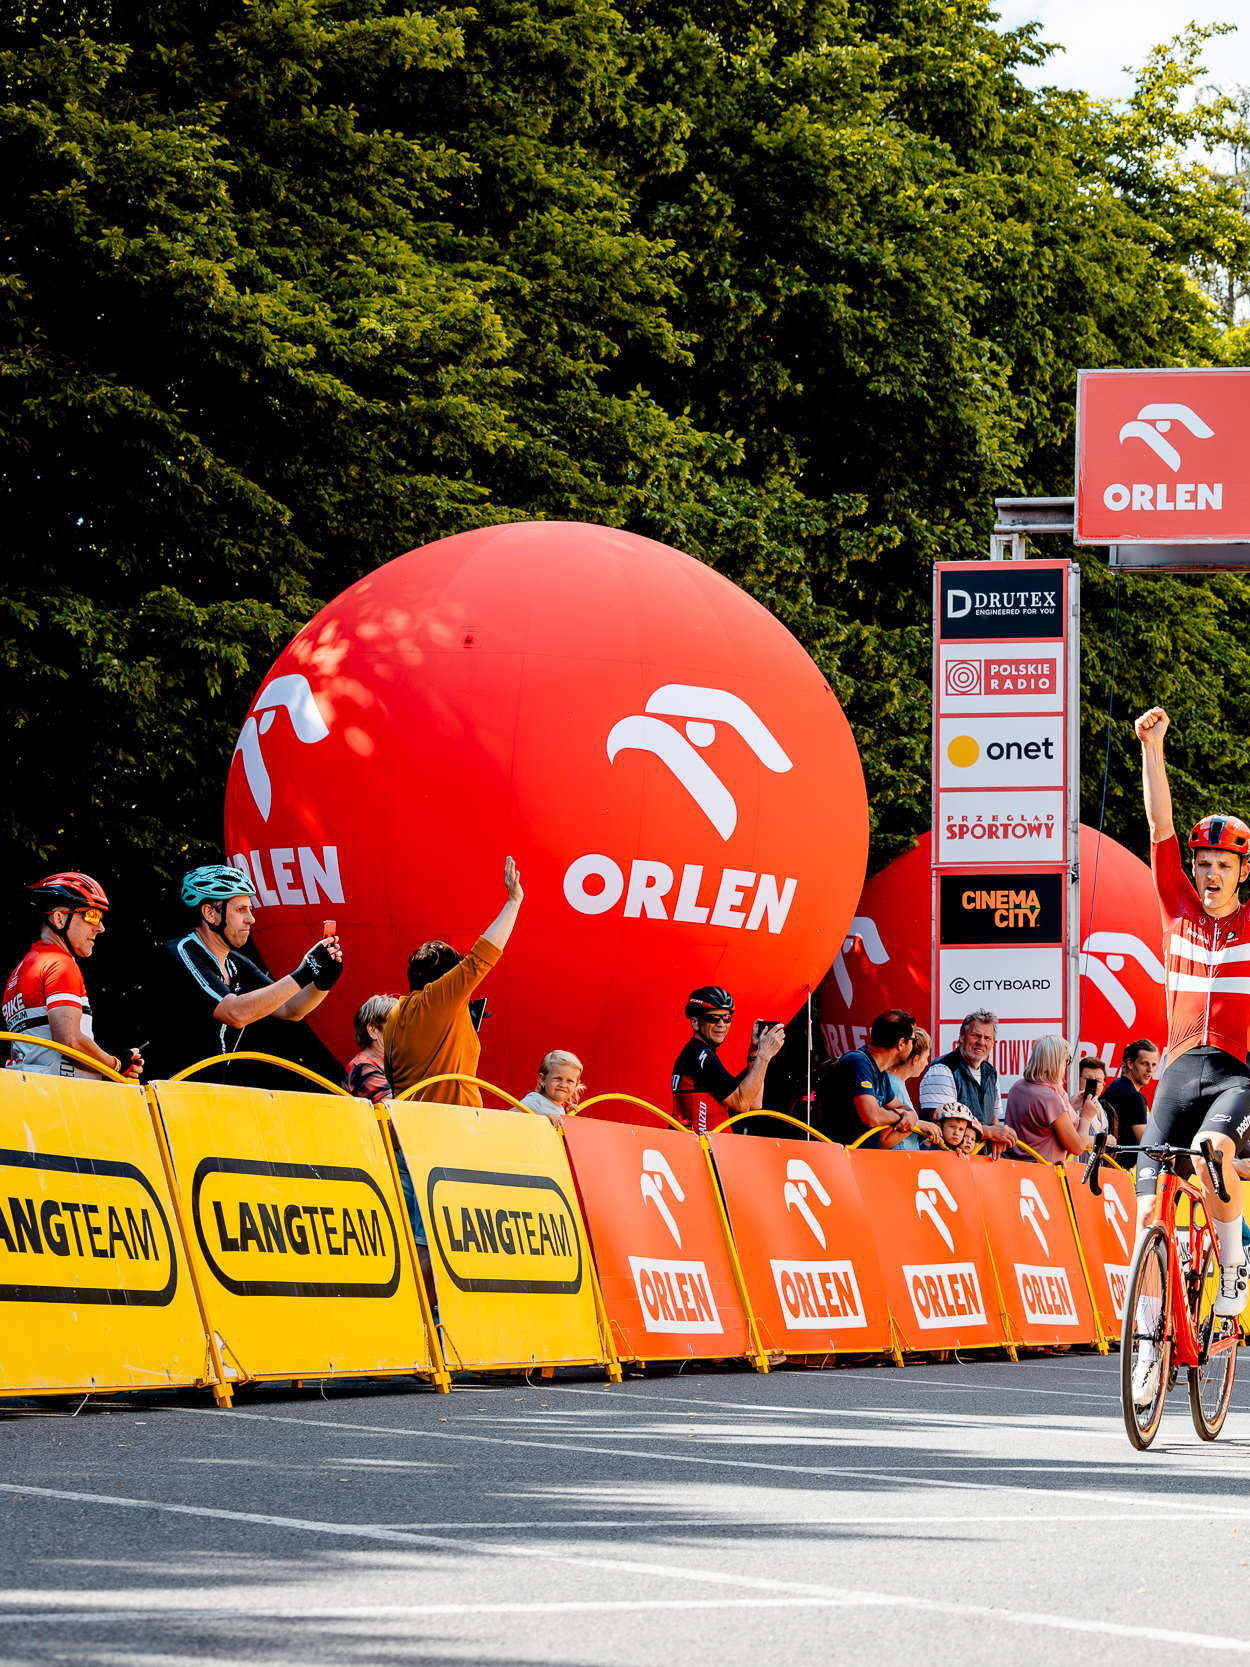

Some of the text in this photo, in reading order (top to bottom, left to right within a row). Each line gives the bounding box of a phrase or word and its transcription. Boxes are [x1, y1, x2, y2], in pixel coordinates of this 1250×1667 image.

[1103, 483, 1223, 511] ORLEN
[974, 591, 1056, 608] DRUTEX
[975, 608, 1020, 616] ENGINEERED
[1039, 607, 1055, 615] YOU
[990, 664, 1050, 675] POLSKIE
[990, 678, 1050, 690] RADIO
[986, 736, 1054, 760] onet
[946, 823, 1055, 840] SPORTOWY
[227, 846, 345, 908] RLEN
[563, 853, 798, 935] ORLEN
[961, 890, 1041, 910] CINEMA
[994, 908, 1041, 928] CITY
[973, 977, 1051, 991] CITYBOARD
[820, 1022, 873, 1058] ORLE
[0, 1197, 160, 1261] ANGTEAM
[213, 1200, 386, 1257] LANGTEAM
[442, 1205, 573, 1257] LANGTEAM
[638, 1267, 715, 1322] ORLEN
[780, 1270, 854, 1318] ORLEN
[913, 1273, 977, 1317] ORLEN
[1021, 1273, 1072, 1316] ORLEN
